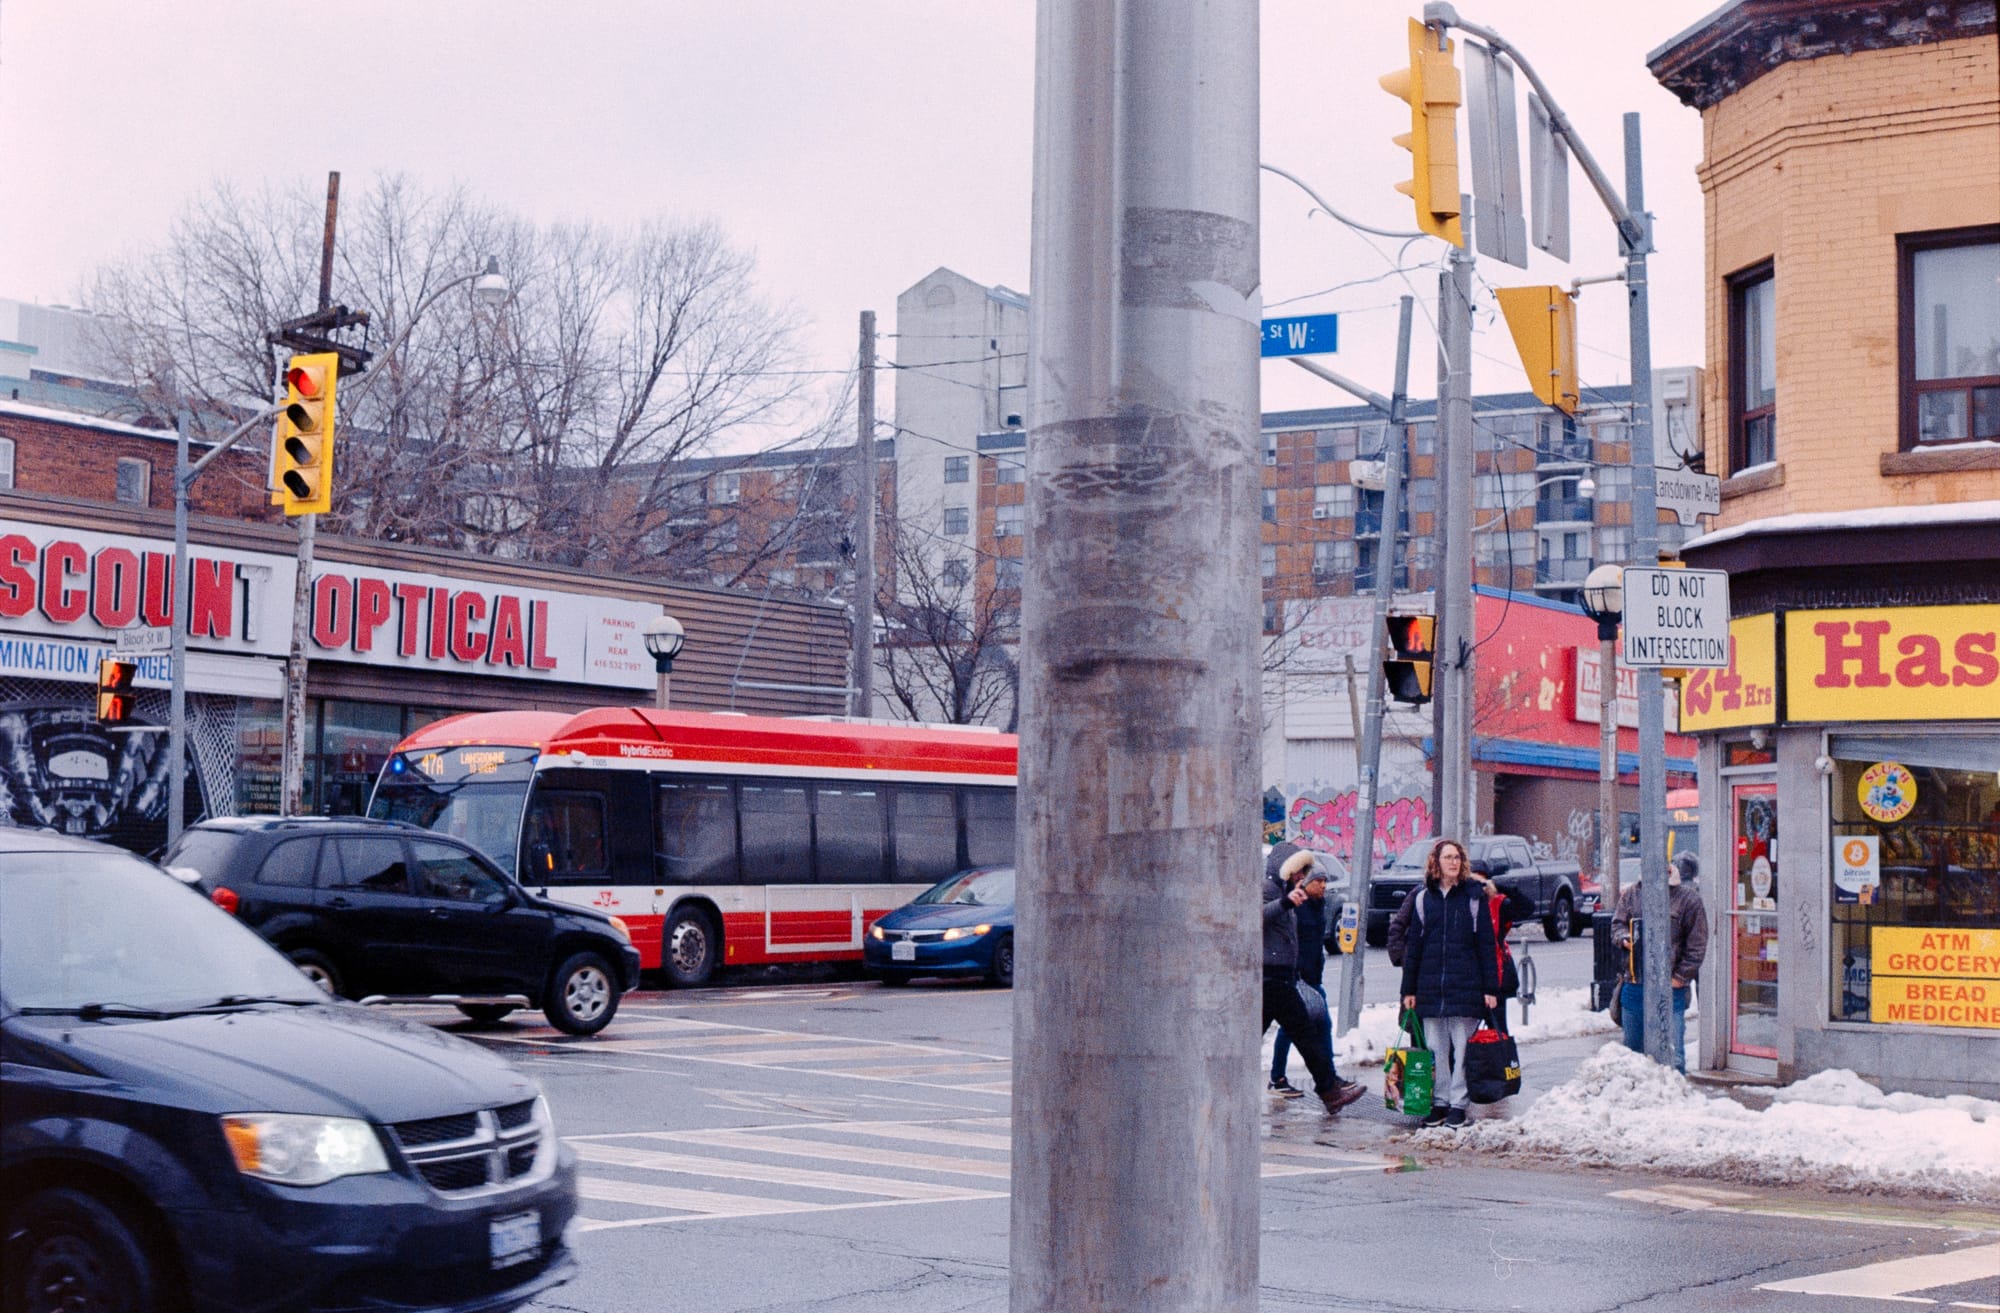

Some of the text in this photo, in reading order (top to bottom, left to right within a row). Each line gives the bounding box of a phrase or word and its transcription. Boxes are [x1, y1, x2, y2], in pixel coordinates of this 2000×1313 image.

[1269, 324, 1283, 339] St
[1704, 481, 1719, 504] Ave
[1652, 574, 1705, 598] DO NOT
[0, 534, 558, 670] SCOUNT OPTICAL
[602, 617, 636, 630] PARKING
[1657, 606, 1704, 629] BLOCK
[123, 630, 165, 646] Bloor St W
[614, 633, 624, 641] AT
[608, 646, 629, 656] REAR
[1632, 636, 1724, 660] INTERSECTION
[1685, 634, 1773, 718] 24 Hrs
[1843, 868, 1871, 877] bitcoin
[1921, 932, 1970, 951] ATM
[1888, 953, 2000, 974] GROCERY
[1906, 983, 1986, 1003] BREAD
[1887, 1003, 2000, 1024] MEDICINE
